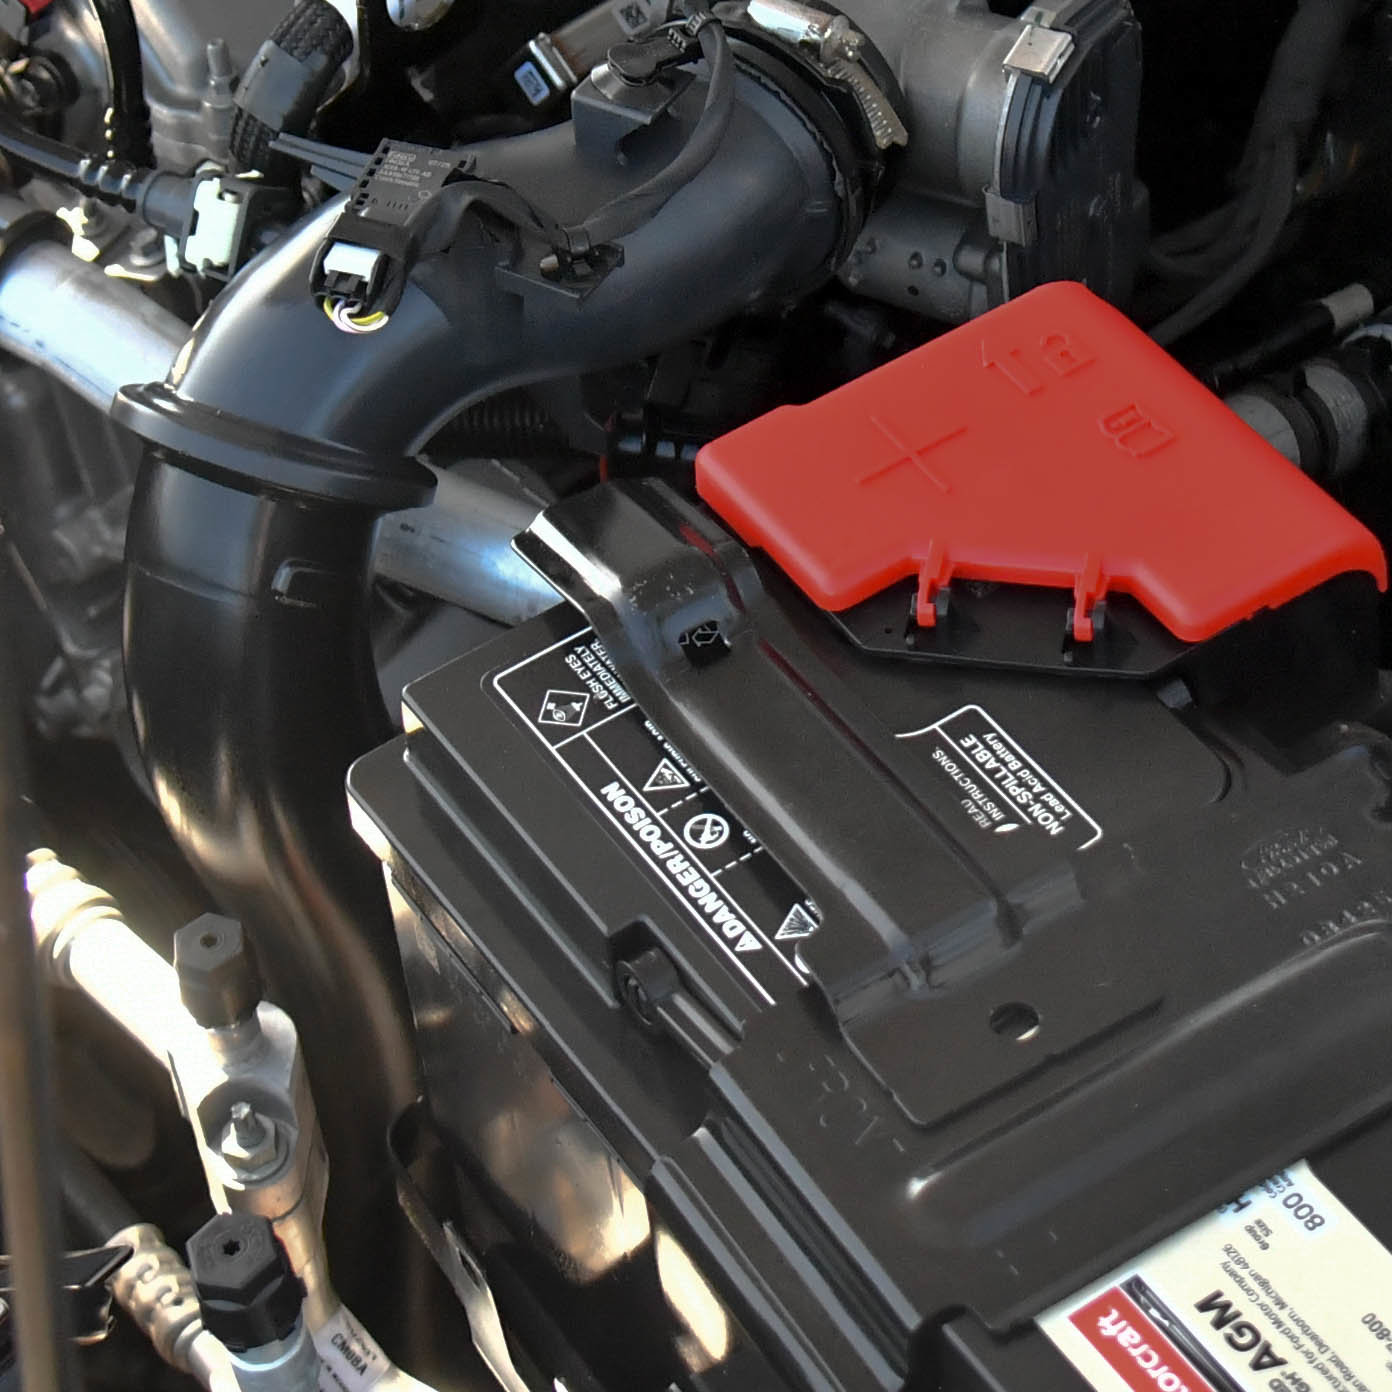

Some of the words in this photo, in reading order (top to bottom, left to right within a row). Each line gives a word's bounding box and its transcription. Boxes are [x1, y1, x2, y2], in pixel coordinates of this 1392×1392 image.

[564, 653, 592, 681] EYES
[573, 645, 632, 707] IMMEDIATELY
[585, 677, 619, 710] FLUSH
[982, 732, 1023, 772] Battery
[932, 749, 1005, 821] INSTRUCTIONS.
[959, 733, 1064, 836] NON-SPILLABLE
[1016, 768, 1047, 793] Acid
[1039, 792, 1073, 821] Lead
[599, 781, 747, 939] DANGER/POISON
[1253, 1218, 1273, 1238] Size
[1281, 1192, 1326, 1232] 800
[1244, 1224, 1270, 1251] Group
[1222, 1243, 1251, 1270] 48126
[1219, 1260, 1260, 1303] Company
[1248, 1269, 1289, 1311] Michigan
[1193, 1289, 1289, 1372] AGM
[1255, 1302, 1287, 1330] Motor
[1287, 1307, 1331, 1356] Dearborn,
[1279, 1326, 1306, 1351] Ford
[1299, 1348, 1319, 1365] for
